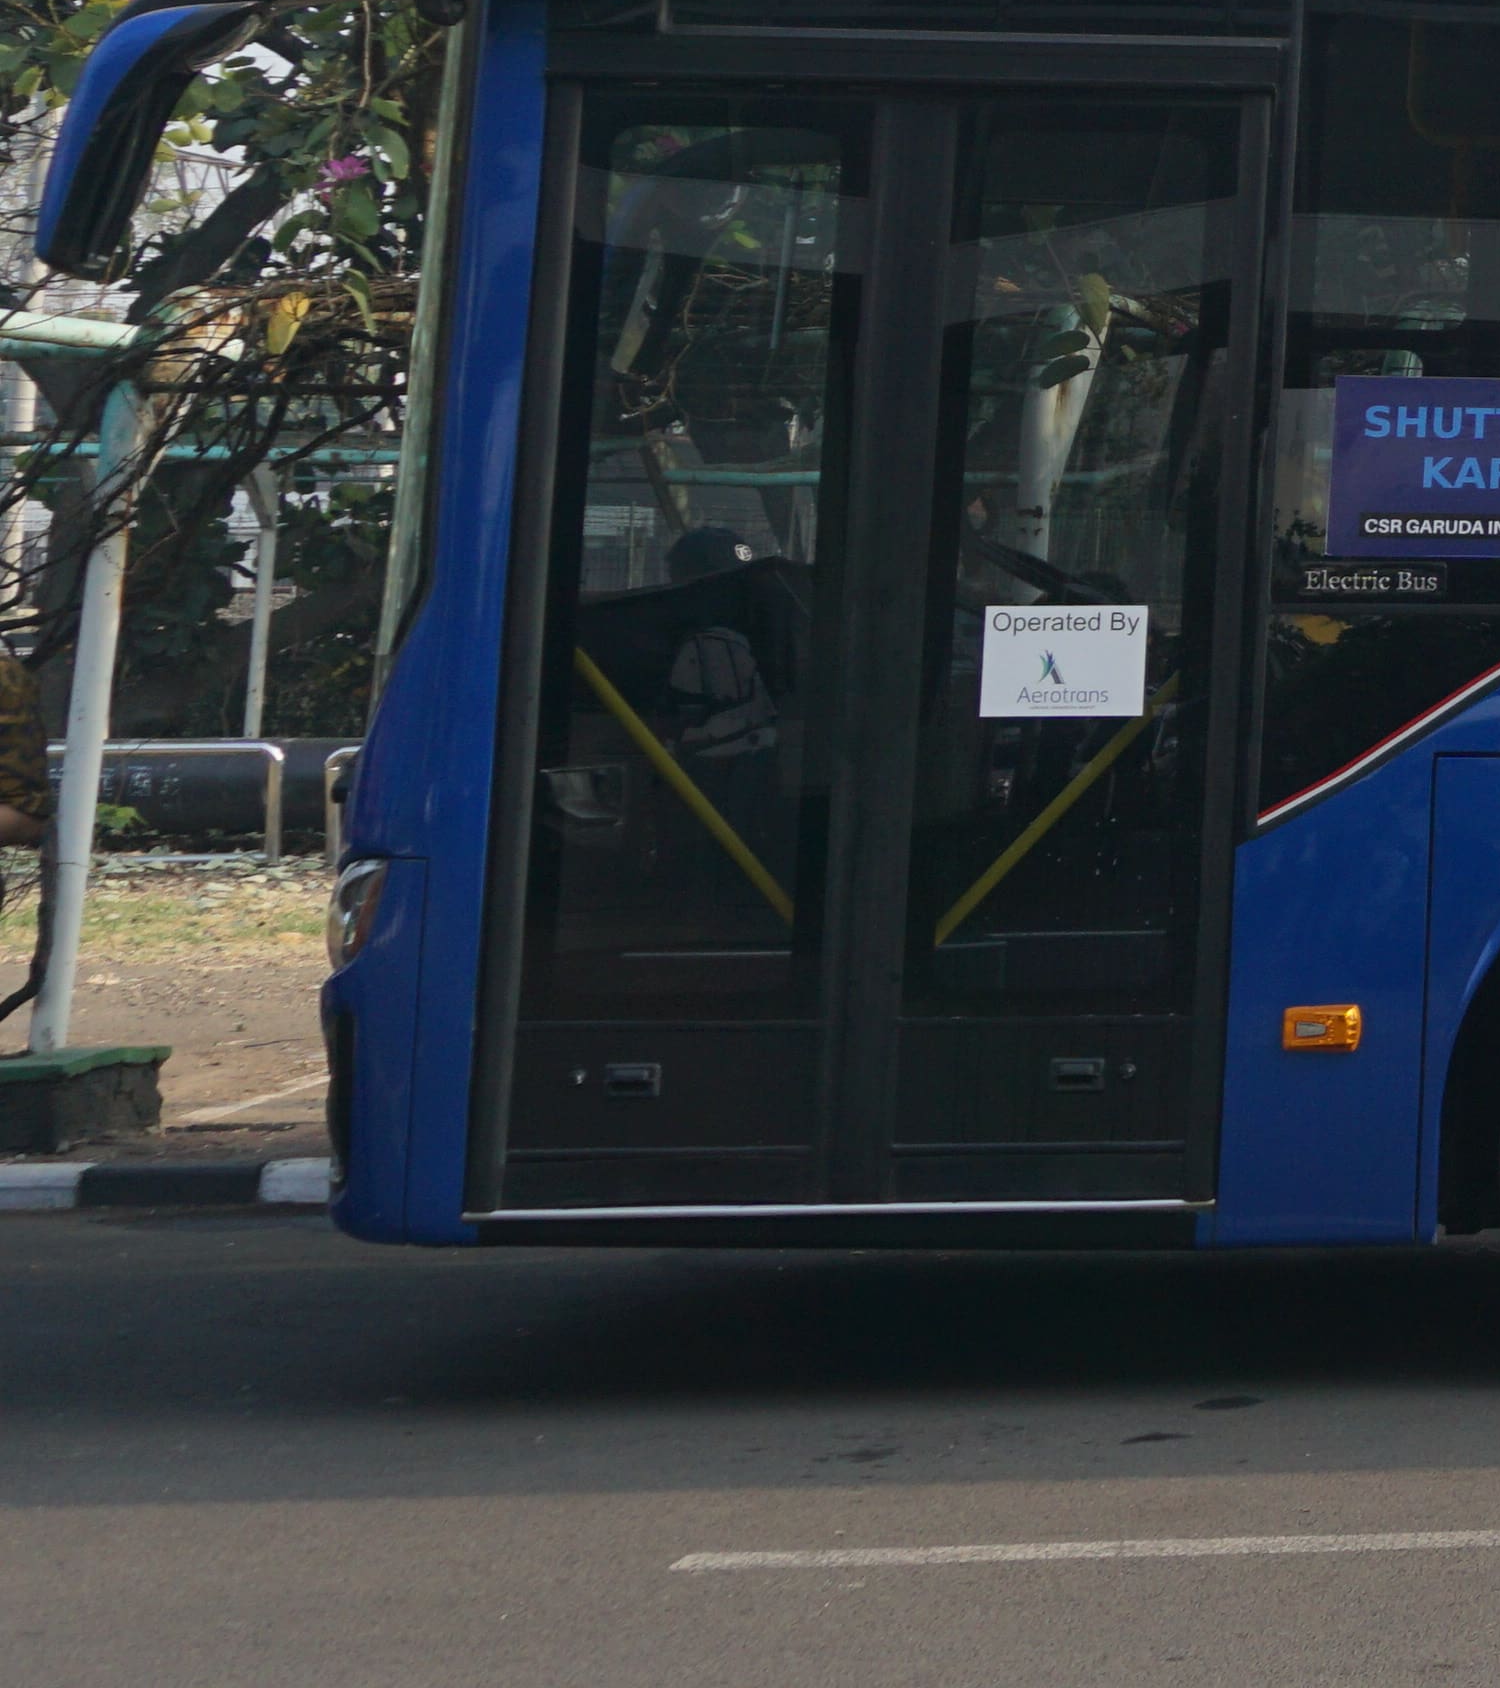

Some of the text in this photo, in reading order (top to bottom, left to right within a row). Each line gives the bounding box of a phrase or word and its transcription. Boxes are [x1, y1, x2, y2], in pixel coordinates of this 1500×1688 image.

[1364, 518, 1402, 534] CSR
[1406, 518, 1484, 535] GARUDA
[1305, 570, 1438, 591] Electric Bus
[993, 612, 1140, 636] Operated By
[1016, 686, 1109, 703] Aerotrans
